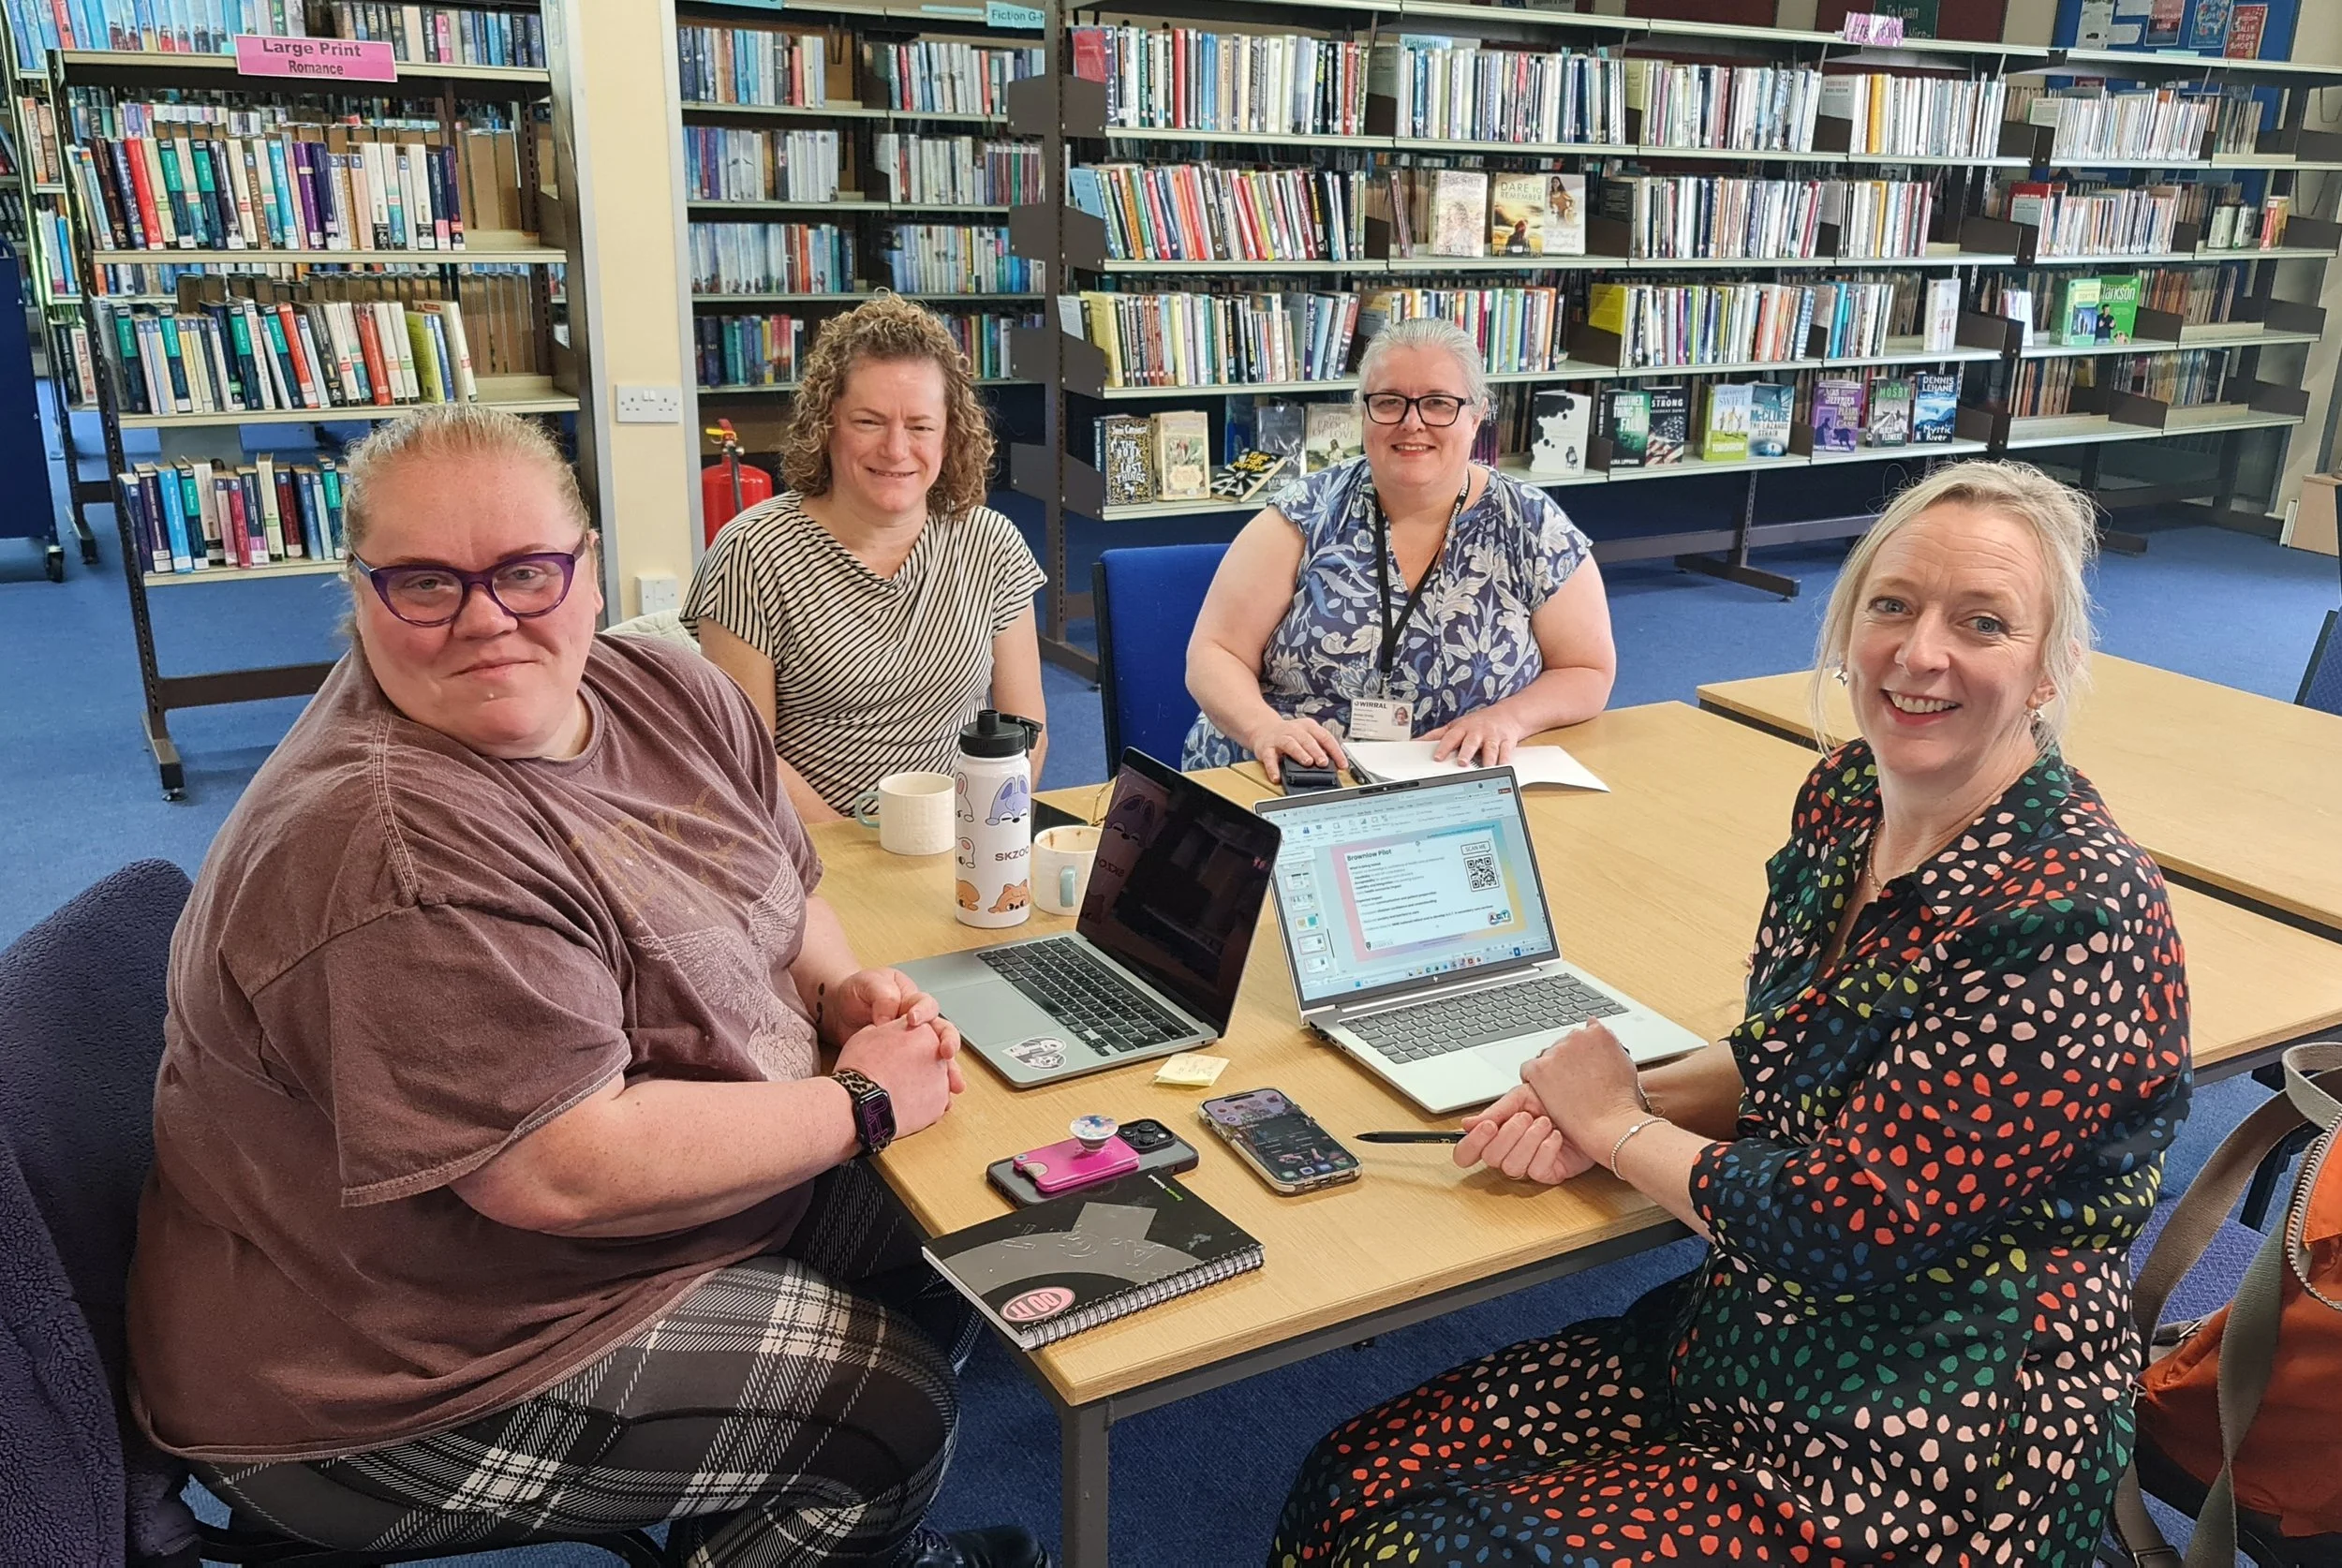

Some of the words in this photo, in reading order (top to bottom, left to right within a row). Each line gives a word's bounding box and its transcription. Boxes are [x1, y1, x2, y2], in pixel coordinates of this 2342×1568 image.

[991, 9, 1026, 21] Fiction
[1897, 5, 1919, 19] Loan
[262, 39, 314, 57] Large
[320, 42, 362, 57] Print
[289, 60, 344, 75] Romance
[1501, 182, 1529, 192] DARE
[1500, 192, 1542, 201] REMEMBER
[2099, 284, 2136, 301] larkson
[1939, 318, 1950, 333] 44
[1923, 377, 1954, 385] DENNIS
[1922, 383, 1954, 392] LEHANE
[1879, 388, 1909, 398] MOSBY
[1614, 394, 1644, 407] ANOTHER
[1652, 399, 1683, 407] STRONG
[1718, 395, 1745, 406] SWIFT
[1613, 407, 1634, 418] THING
[1317, 421, 1350, 431] PROOF
[1923, 423, 1951, 436] Mystic
[1329, 430, 1356, 439] LOVE
[1926, 432, 1948, 442] River
[1120, 440, 1136, 450] THE
[1117, 448, 1142, 458] BOOK
[1120, 462, 1143, 472] LOST
[1116, 472, 1147, 484] THINGS
[1465, 844, 1479, 852] SCAN
[1347, 851, 1377, 862] Brownlow
[1010, 1300, 1037, 1319] IT
